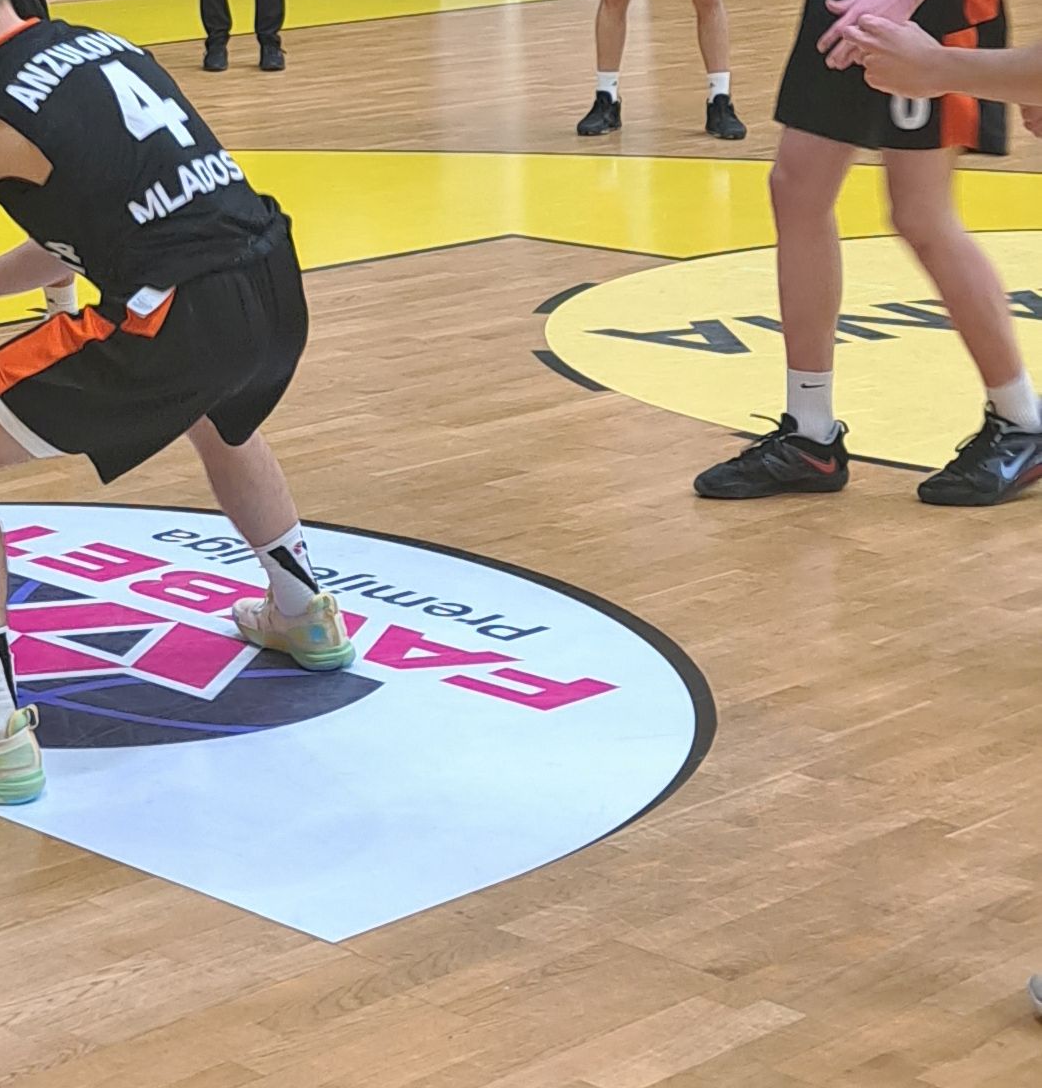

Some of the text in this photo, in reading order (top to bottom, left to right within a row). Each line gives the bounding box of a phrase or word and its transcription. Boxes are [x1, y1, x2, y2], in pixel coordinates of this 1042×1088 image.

[100, 60, 196, 148] 4
[3, 524, 621, 711] FABET
[151, 528, 550, 642] Premije liga
